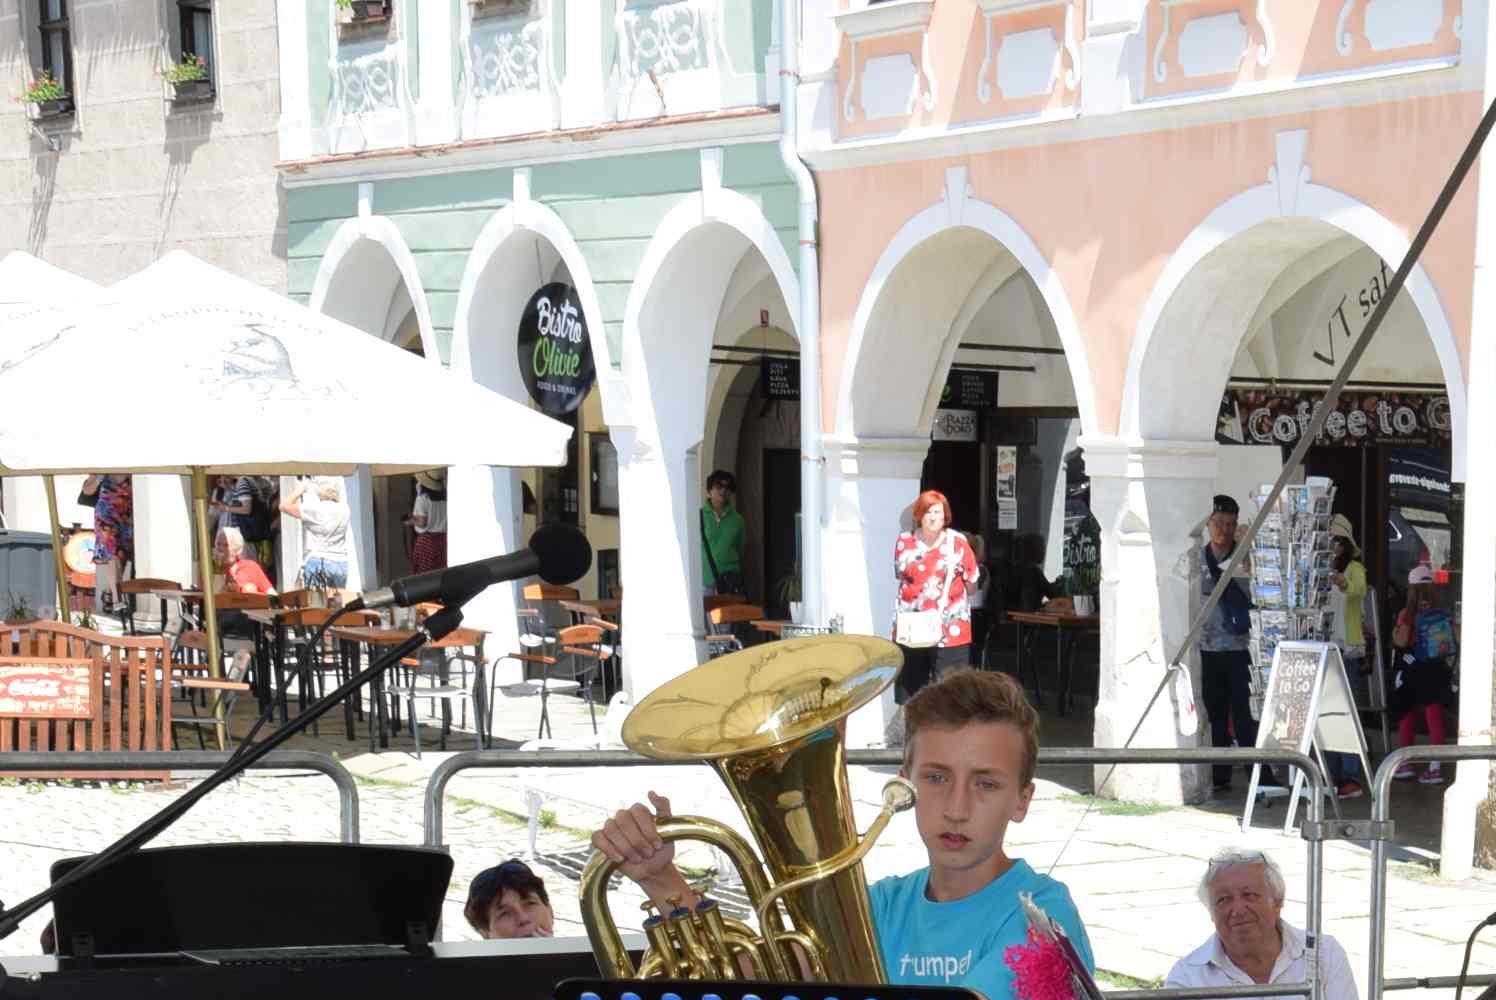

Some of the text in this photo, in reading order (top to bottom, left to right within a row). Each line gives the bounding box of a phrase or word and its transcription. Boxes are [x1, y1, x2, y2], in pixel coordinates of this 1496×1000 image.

[537, 296, 582, 343] Bistro
[533, 337, 580, 377] Olivie
[1376, 399, 1416, 435] to
[1425, 398, 1451, 431] G
[1278, 658, 1317, 678] Coffee
[1279, 680, 1292, 694] to
